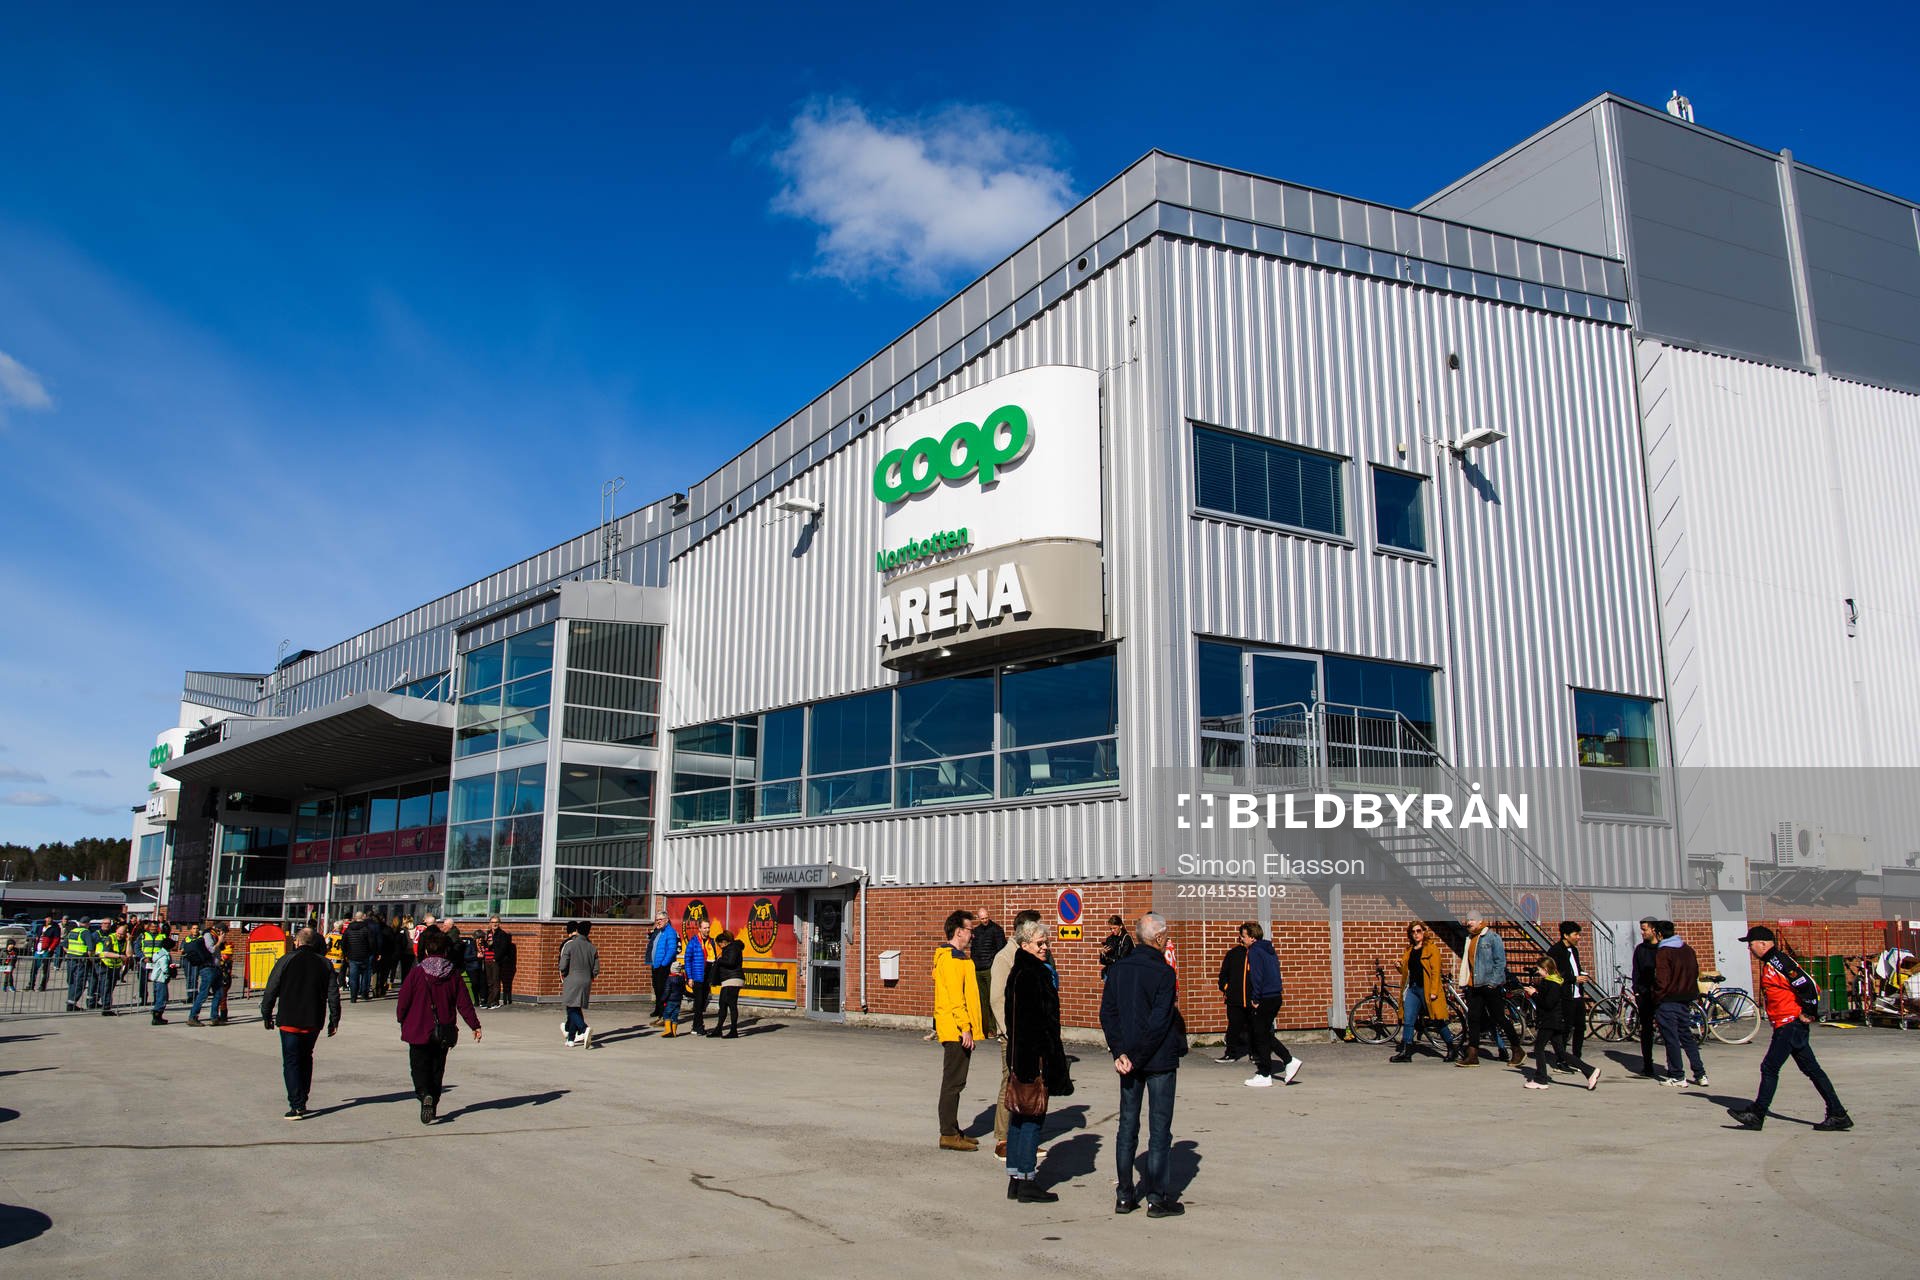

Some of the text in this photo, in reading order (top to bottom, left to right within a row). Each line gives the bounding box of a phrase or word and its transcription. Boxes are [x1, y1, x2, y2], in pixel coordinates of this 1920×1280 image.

[873, 404, 1029, 503] coop
[876, 527, 968, 572] Norrbotten
[875, 562, 1028, 646] ARENA
[762, 869, 823, 884] HEMMALAGET
[743, 973, 786, 987] OUVENIRBUTIK
